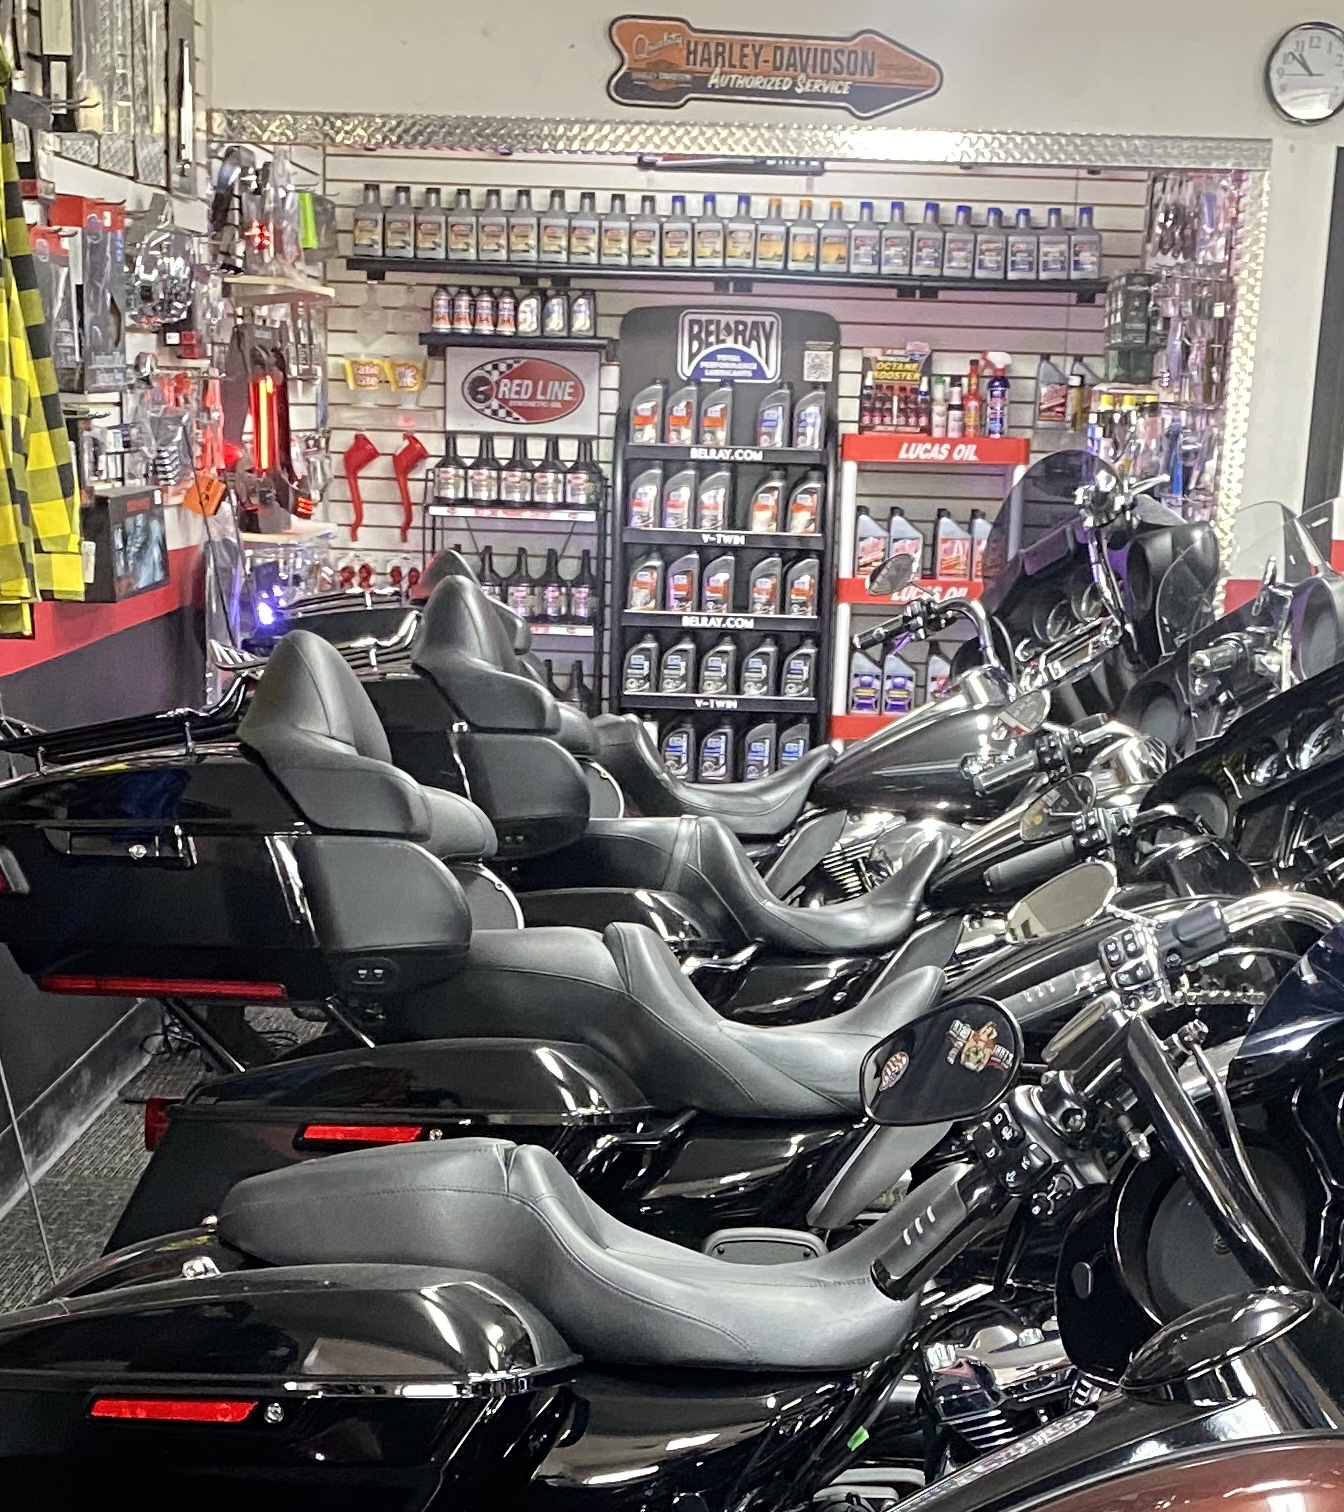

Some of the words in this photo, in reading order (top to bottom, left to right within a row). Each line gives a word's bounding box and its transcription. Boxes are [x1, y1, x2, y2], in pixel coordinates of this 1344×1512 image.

[685, 39, 875, 77] HARLEY-DAVIDSON
[708, 67, 792, 92] AUTHORIZED
[794, 73, 855, 94] SERVICE
[498, 379, 533, 400] RED
[536, 380, 575, 401] LINE
[690, 447, 764, 461] BELRAY.COM
[898, 442, 949, 461] LUCAS
[951, 444, 979, 462] OIL
[701, 534, 745, 545] V-TWIN
[682, 616, 754, 630] BELRAY.COM
[694, 699, 738, 710] V-TWIN
